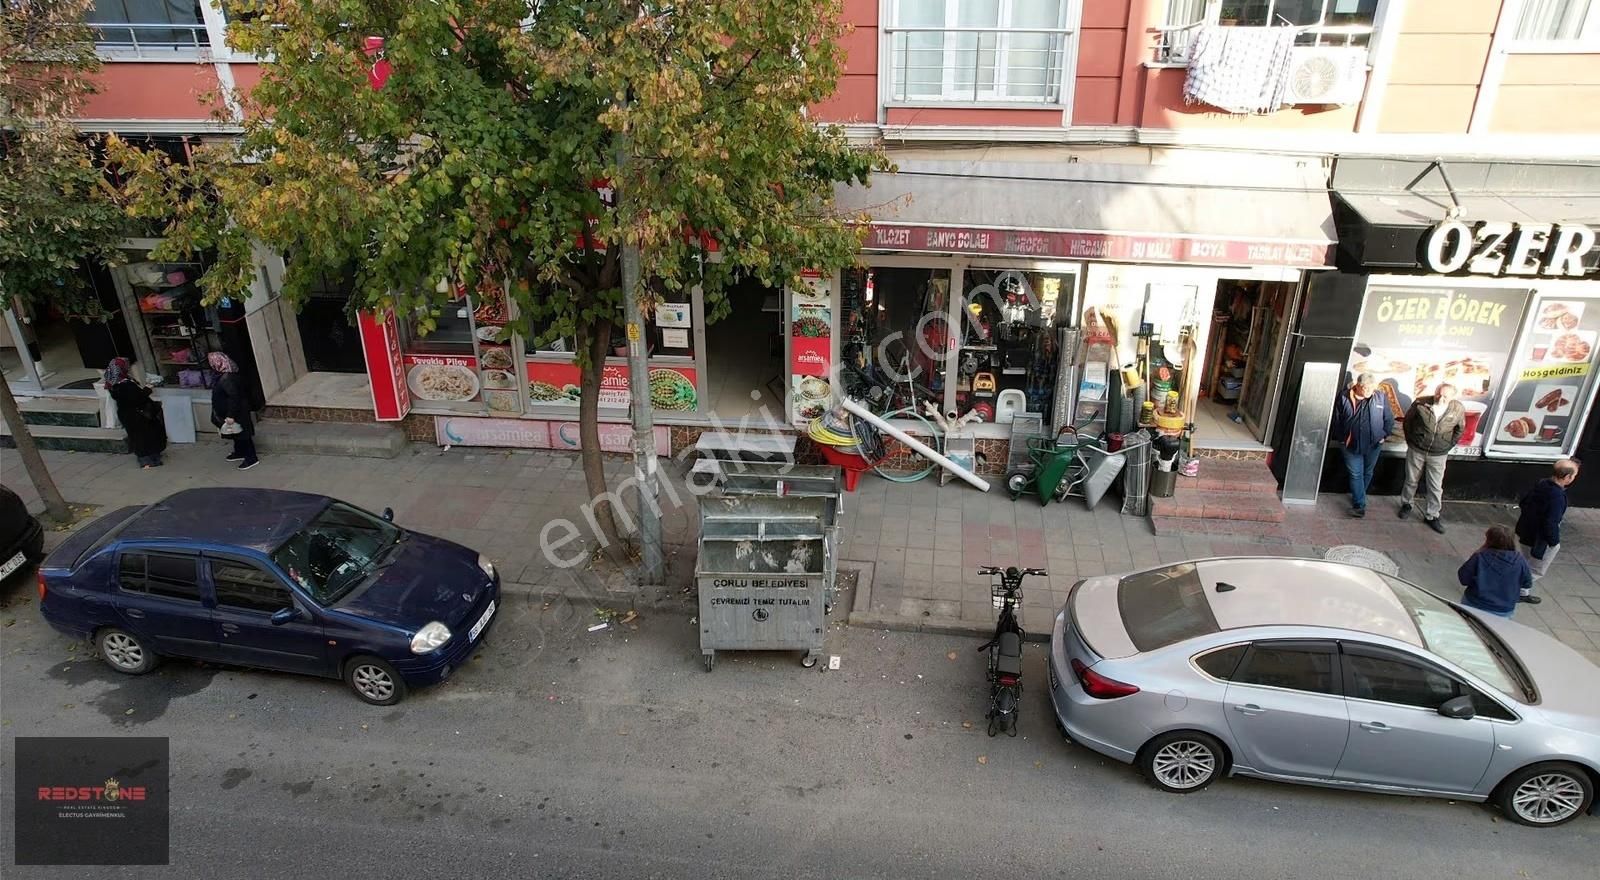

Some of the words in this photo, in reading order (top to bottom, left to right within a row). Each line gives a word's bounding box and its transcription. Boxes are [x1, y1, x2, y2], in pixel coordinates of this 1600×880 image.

[1191, 242, 1226, 257] BOYA
[1376, 295, 1431, 323] ÖZER
[1434, 293, 1507, 328] BÖREK
[713, 579, 748, 588] ÇORLU
[752, 579, 808, 588] BELEDİYESİ
